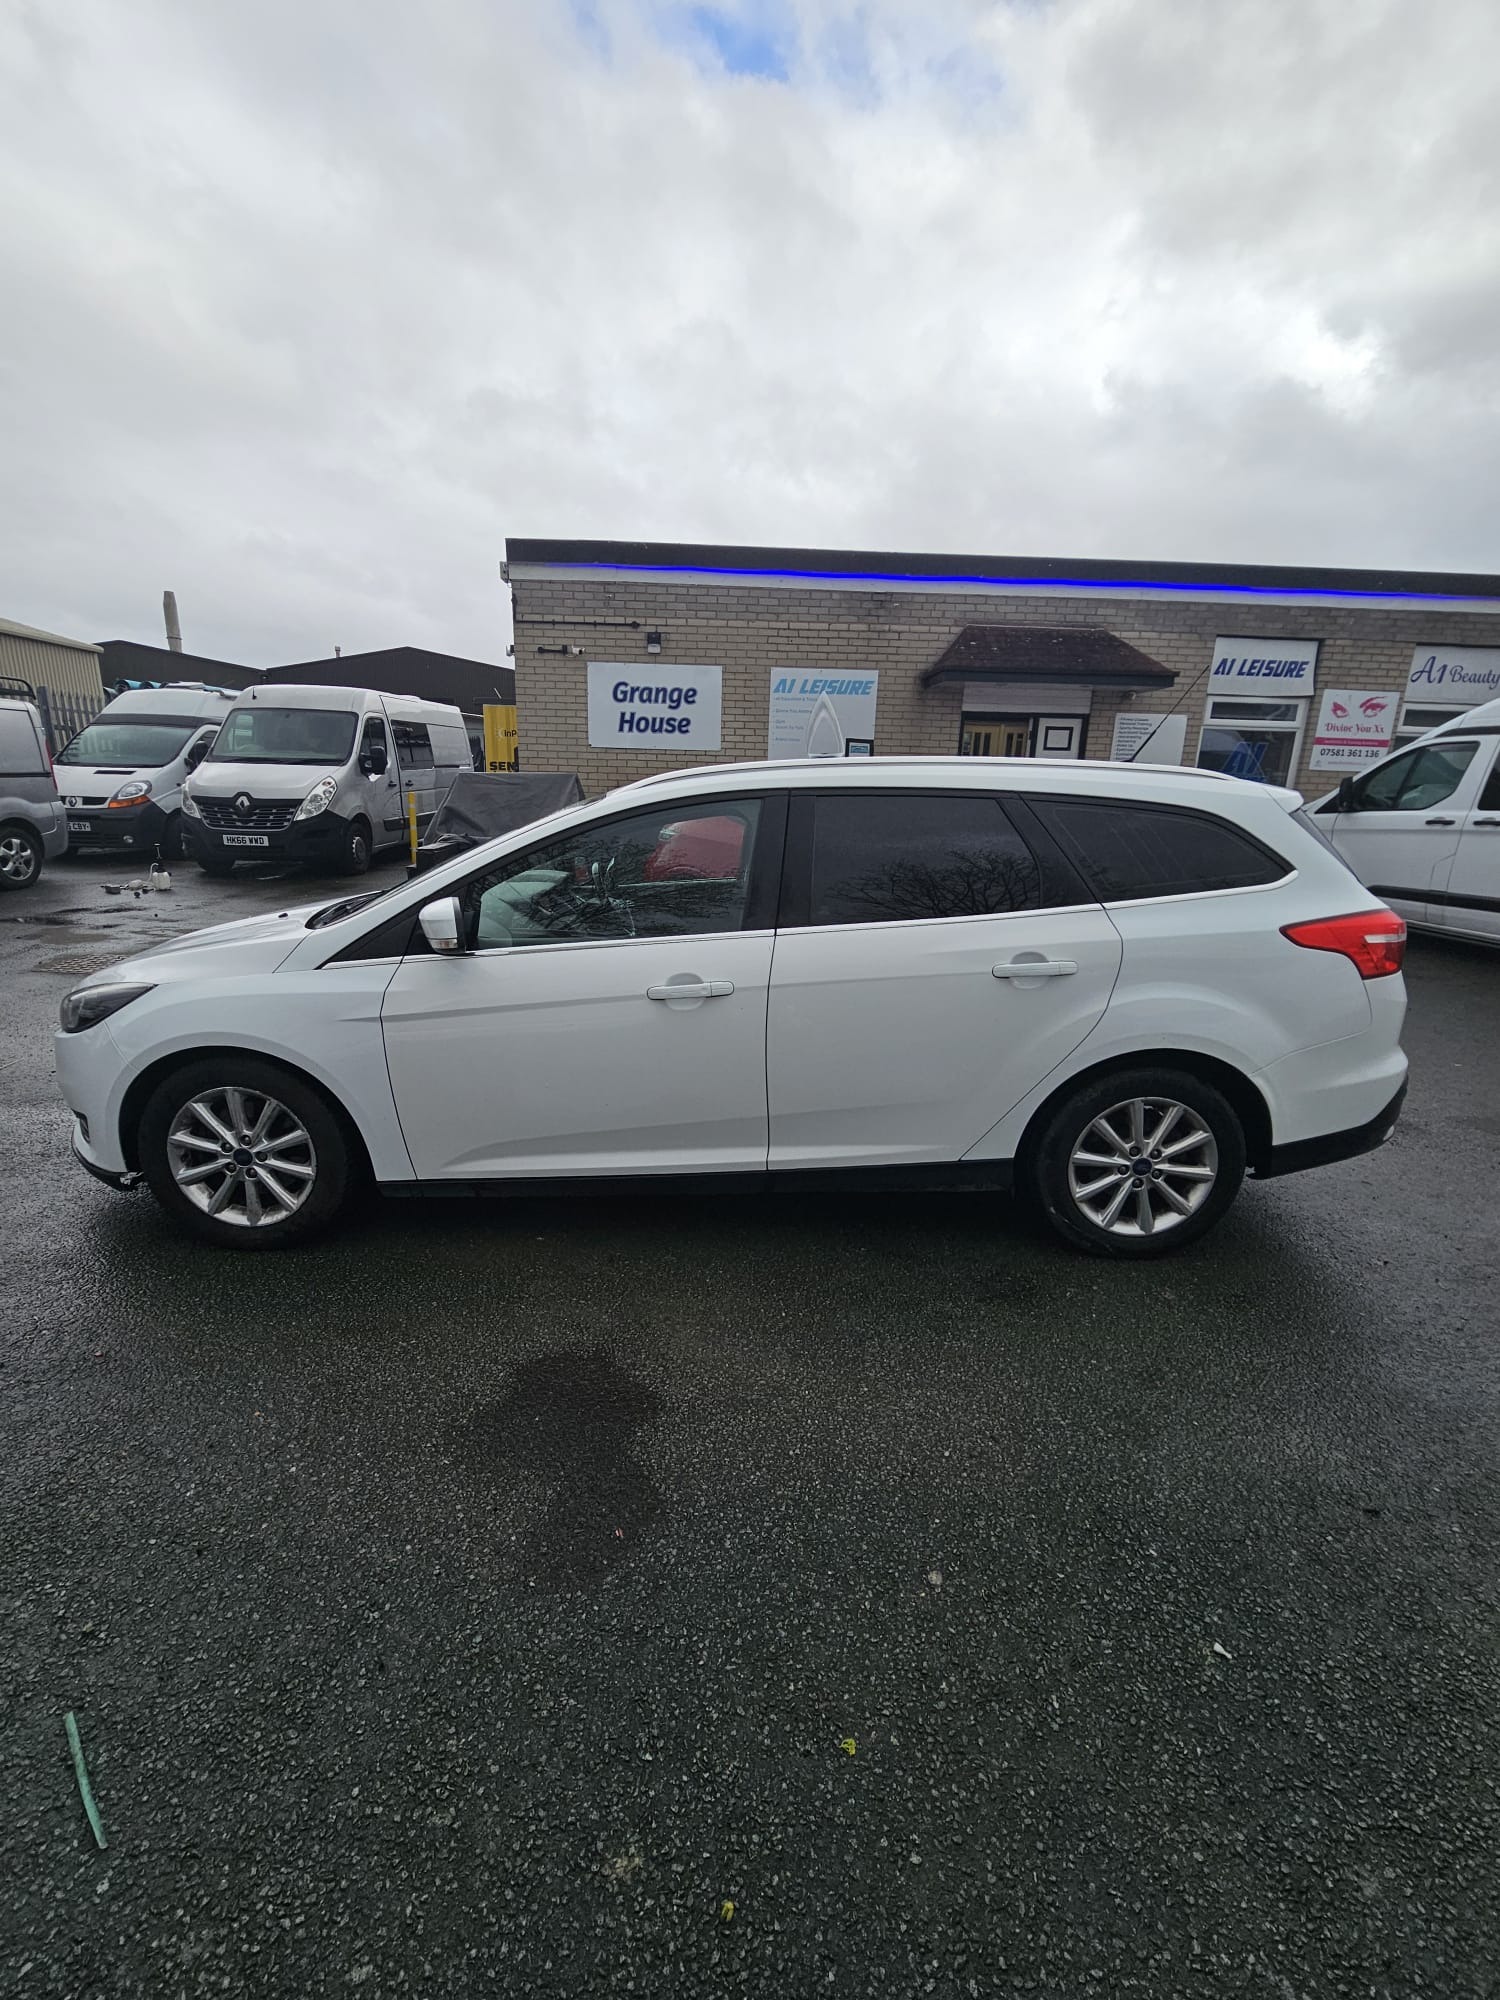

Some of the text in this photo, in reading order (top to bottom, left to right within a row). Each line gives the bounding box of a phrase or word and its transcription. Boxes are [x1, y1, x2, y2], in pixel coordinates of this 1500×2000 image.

[1237, 658, 1310, 678] LEISURE
[1410, 655, 1500, 690] A1 Beauty
[612, 681, 697, 709] Grange
[799, 679, 875, 695] LEISURE
[618, 711, 692, 734] House
[1324, 722, 1354, 733] Divine
[1355, 723, 1372, 735] You
[1320, 748, 1380, 758] 07581 361 136
[226, 836, 265, 845] HK66 WWD
